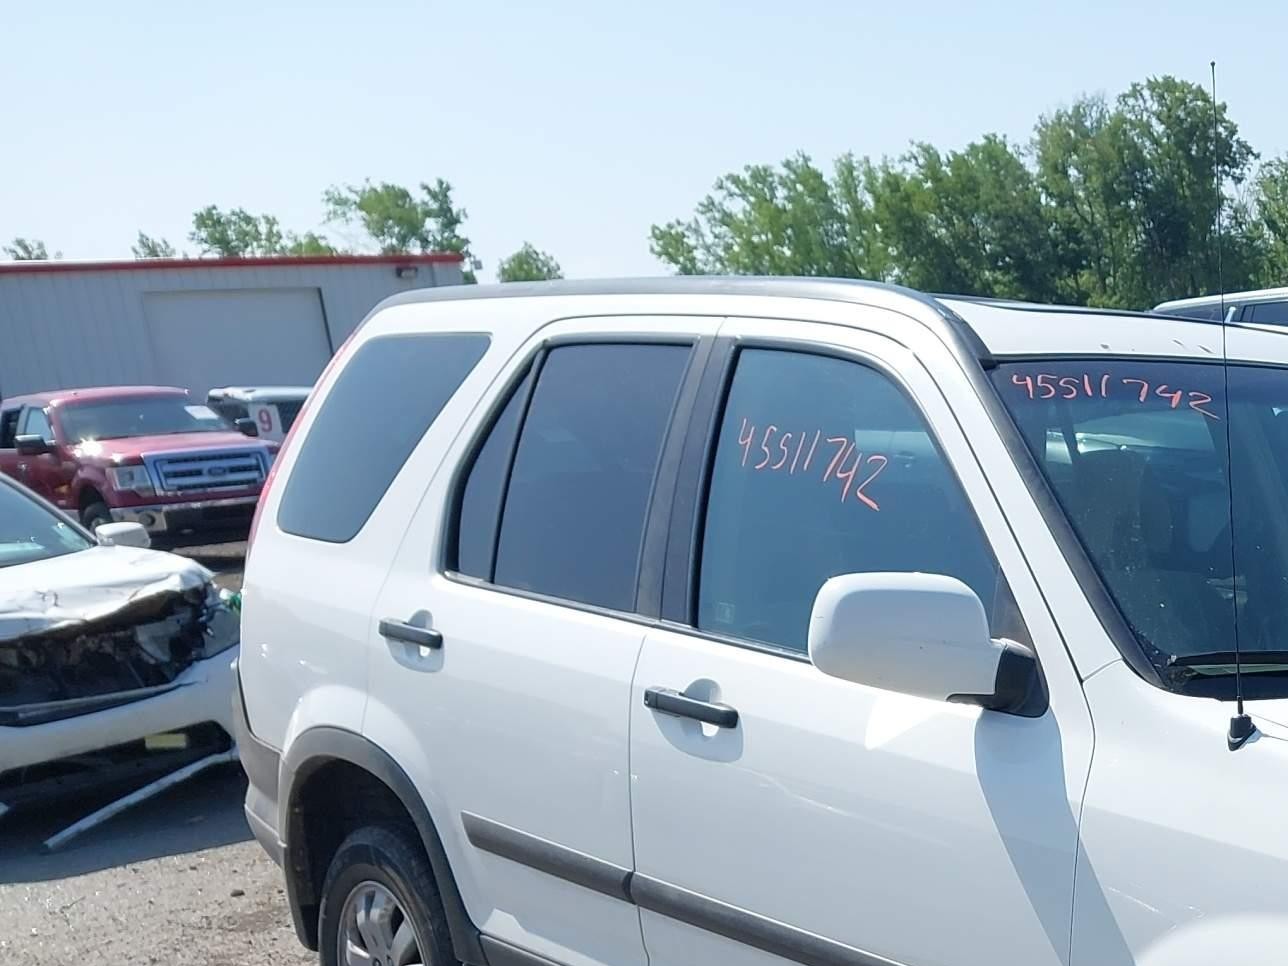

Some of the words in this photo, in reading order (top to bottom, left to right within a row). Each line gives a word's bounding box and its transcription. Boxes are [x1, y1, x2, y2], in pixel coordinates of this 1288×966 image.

[258, 408, 273, 432] 9
[1012, 374, 1221, 421] 45511742
[738, 418, 888, 512] 45511742
